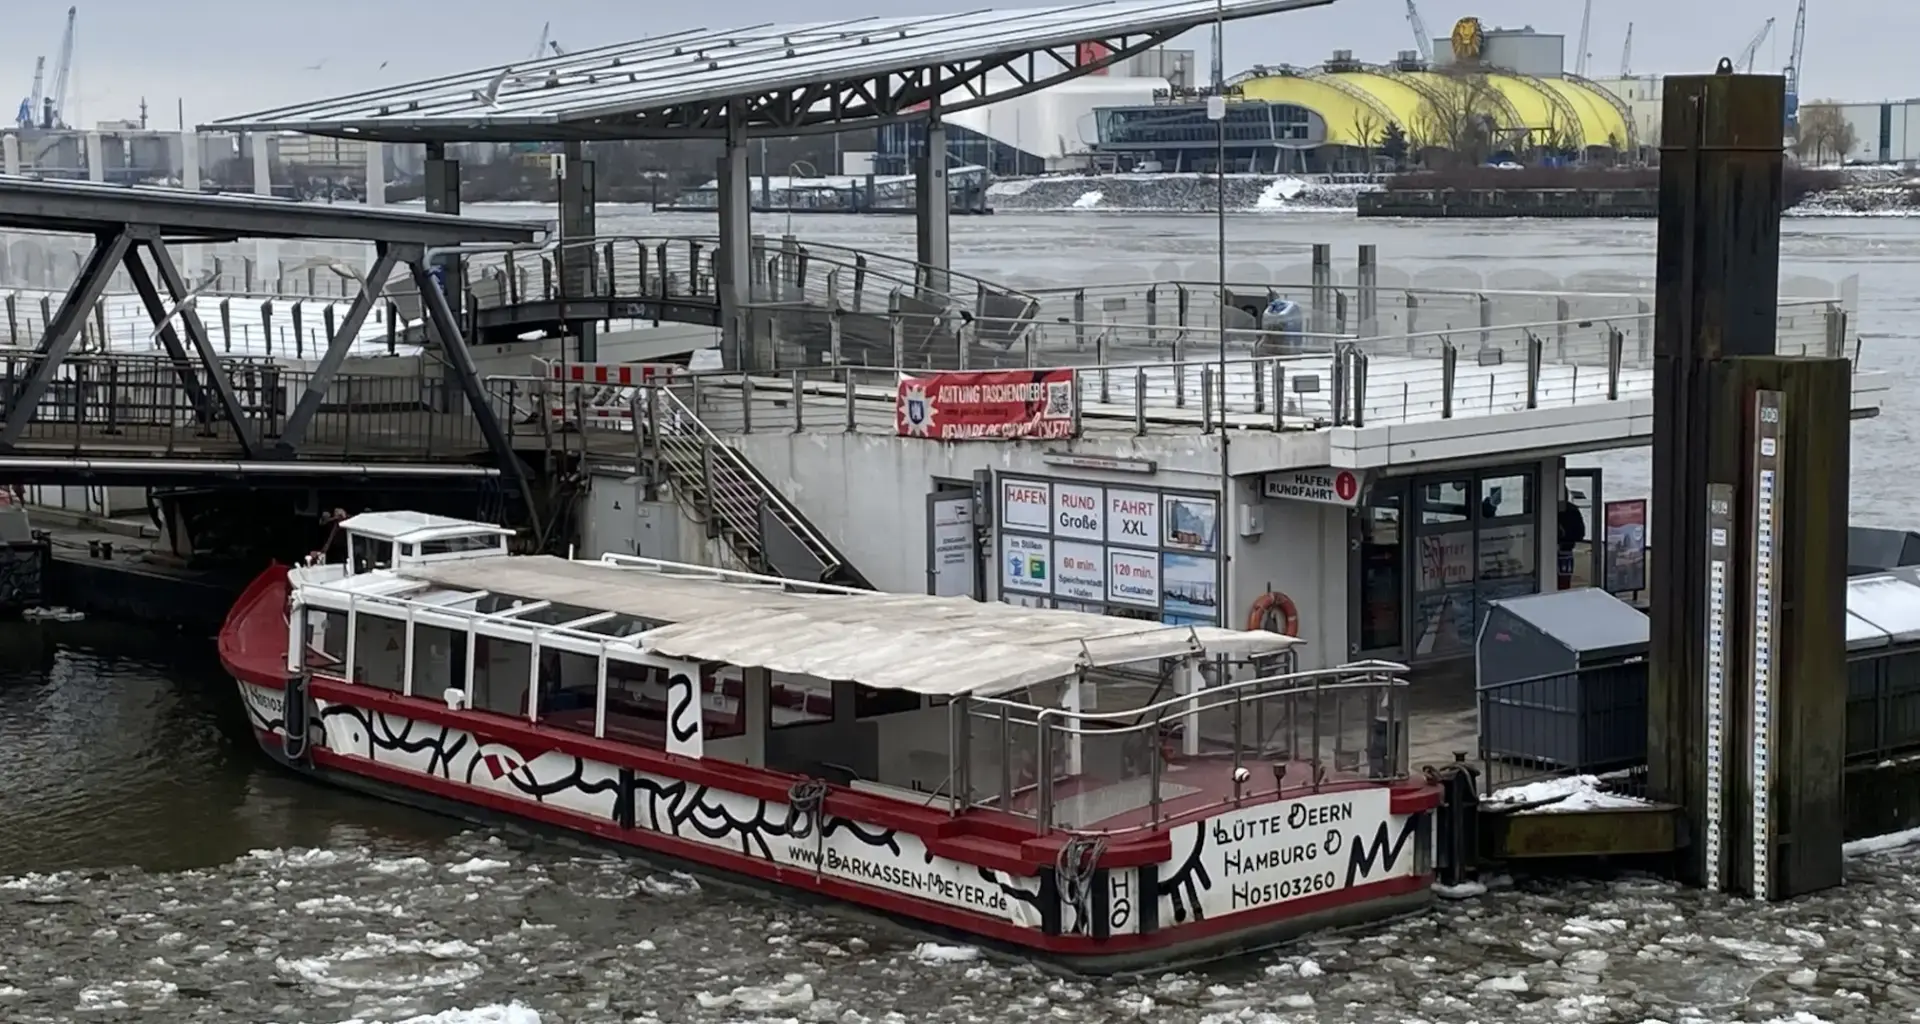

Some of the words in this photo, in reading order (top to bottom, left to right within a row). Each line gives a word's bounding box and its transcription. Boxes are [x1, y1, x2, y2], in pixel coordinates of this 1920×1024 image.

[938, 384, 981, 404] ACHTUNG
[982, 382, 1046, 403] TASCHENDIEBE
[1295, 474, 1333, 487] HAFEN-
[1269, 482, 1334, 500] RUNDFAHRT
[1007, 488, 1047, 506] HAFEN
[1061, 493, 1095, 511] RUND
[1113, 498, 1155, 517] FAHRT
[1059, 512, 1097, 531] Große
[1122, 519, 1148, 536] XXL
[1076, 559, 1097, 572] min.
[1114, 563, 1130, 577] 120
[1133, 566, 1155, 579] min.
[1120, 583, 1154, 596] Container
[1224, 843, 1317, 877] HAMBURG
[1231, 871, 1336, 910] H05103260
